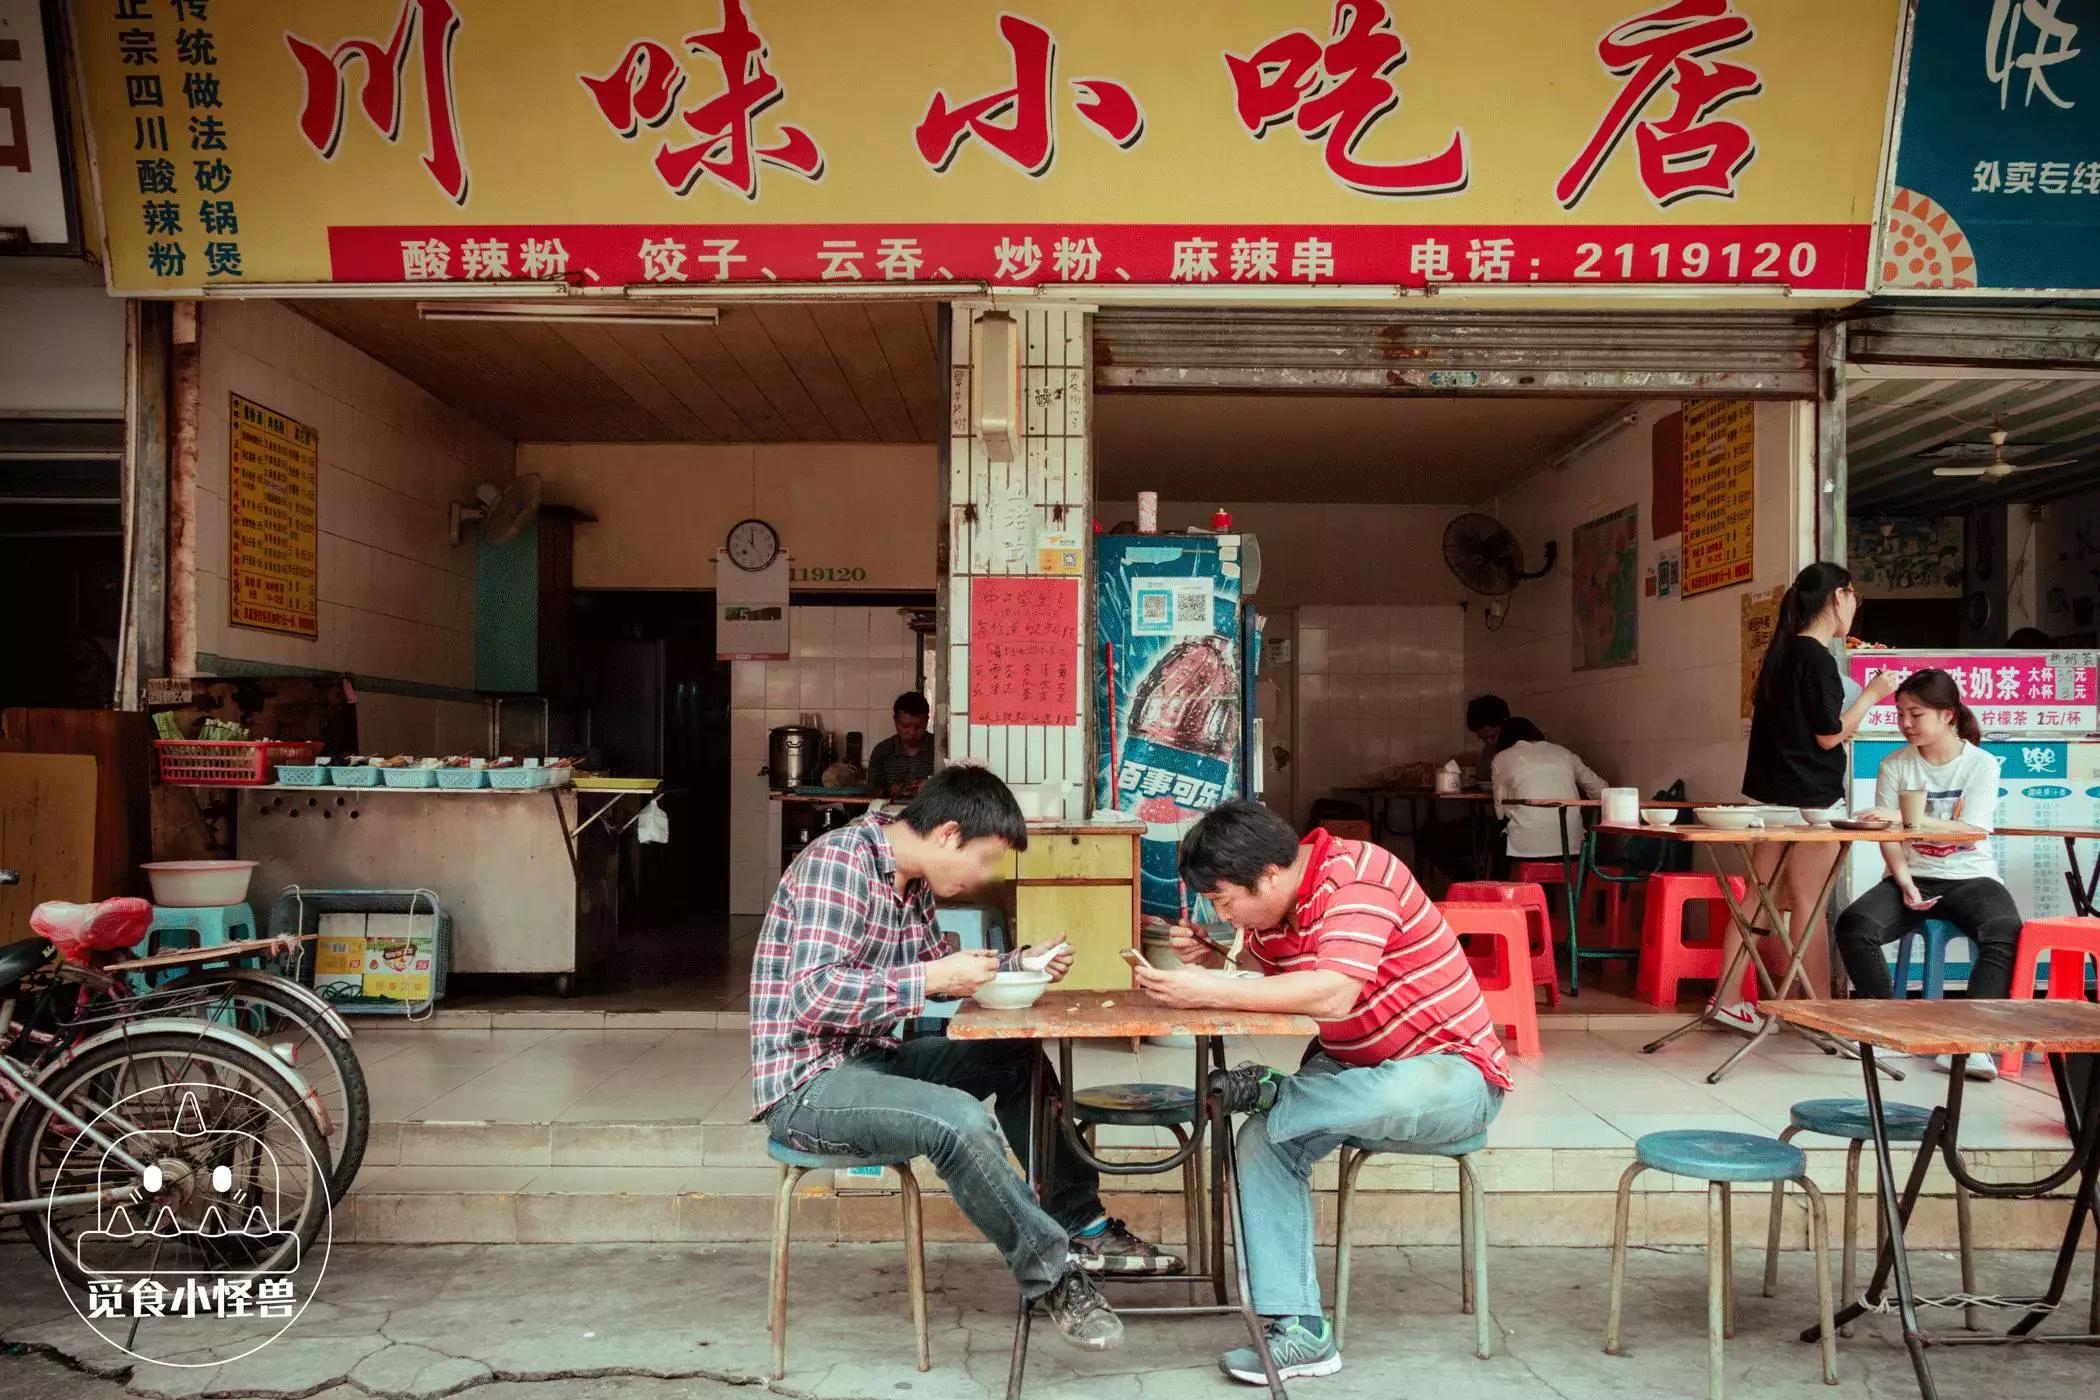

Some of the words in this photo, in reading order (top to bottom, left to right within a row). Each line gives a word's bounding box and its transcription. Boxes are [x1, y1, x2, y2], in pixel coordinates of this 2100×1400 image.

[284, 0, 1762, 210] 川味小吃店
[1971, 160, 2100, 194] 外卖专线
[1117, 760, 1223, 811] 百事可乐
